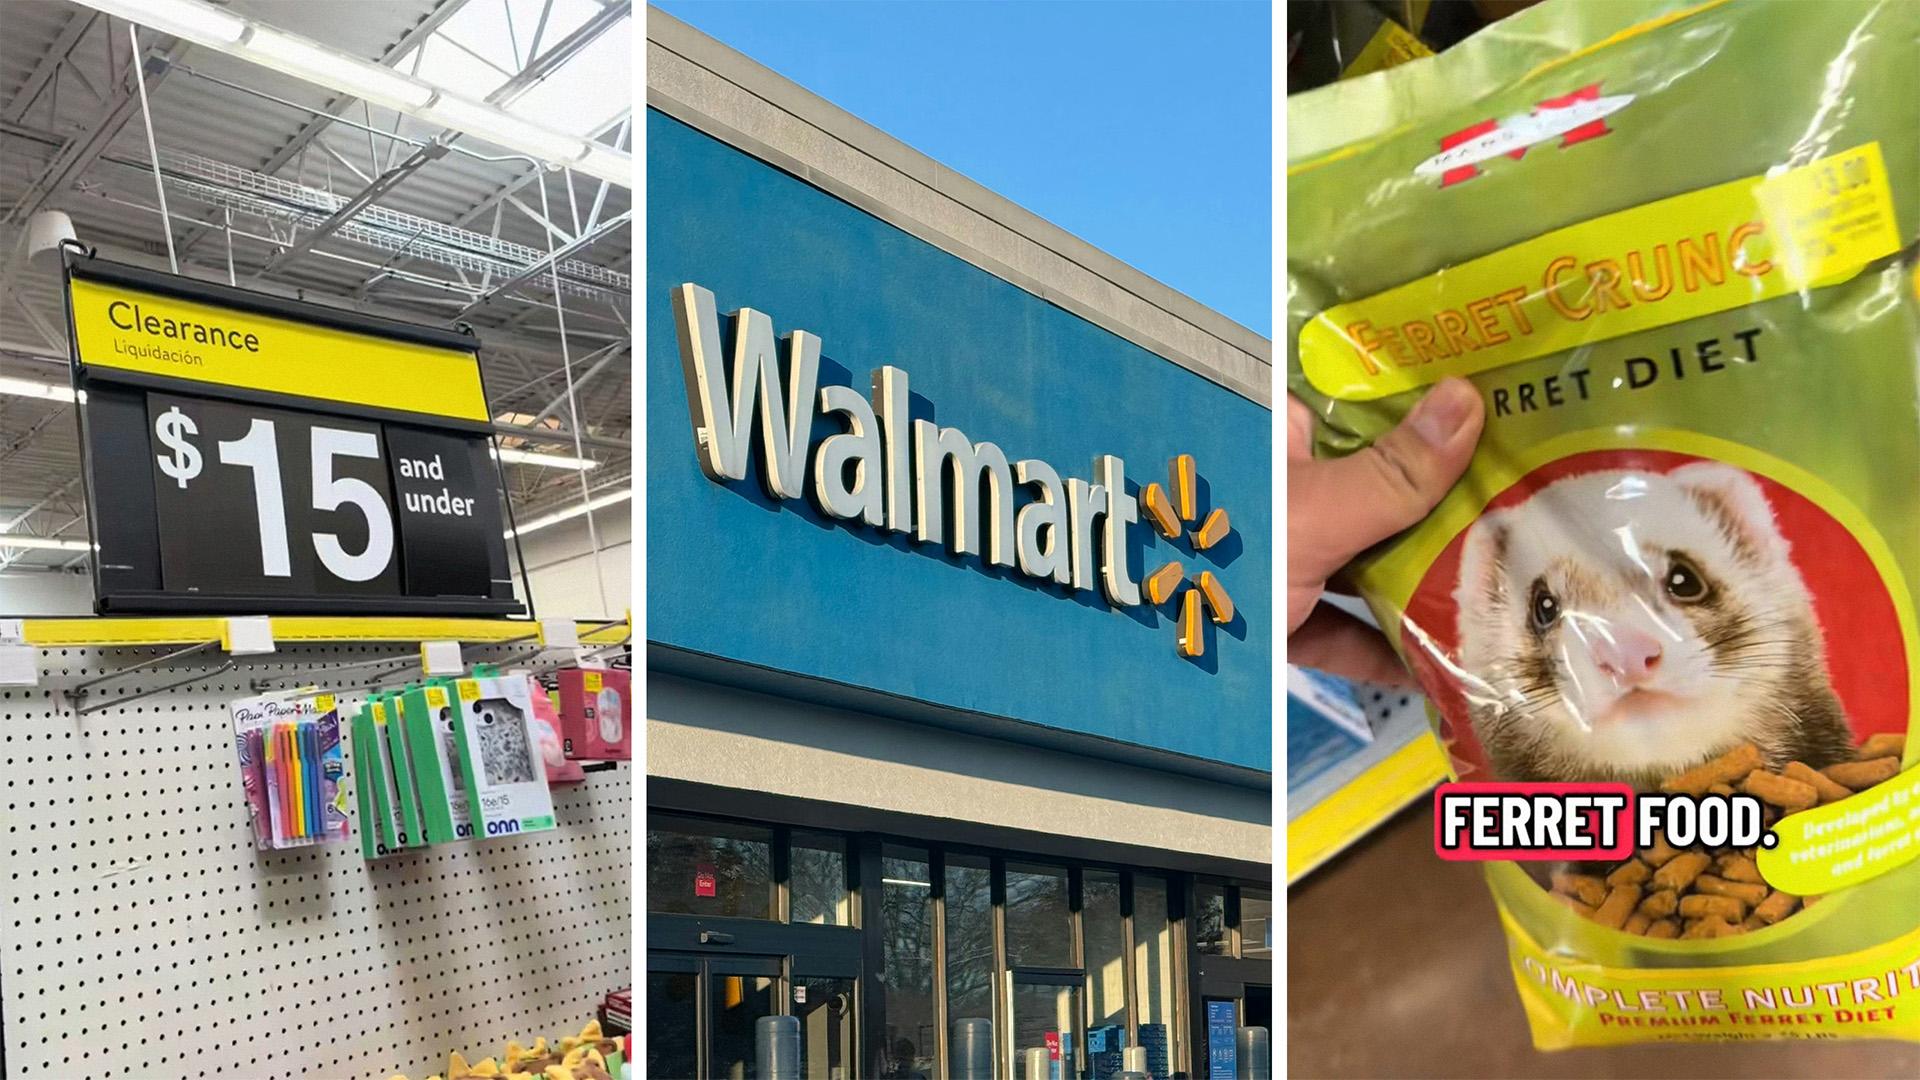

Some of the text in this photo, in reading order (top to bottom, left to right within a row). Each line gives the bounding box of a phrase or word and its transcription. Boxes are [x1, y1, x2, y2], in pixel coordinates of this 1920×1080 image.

[1346, 222, 1775, 375] FERRET CRUNC
[108, 301, 260, 353] Clearance
[113, 338, 203, 367] Liquidación
[1493, 327, 1763, 418] RRET DIET
[671, 283, 1141, 606] Walmart
[400, 455, 444, 481] and
[405, 489, 474, 517] under
[456, 822, 474, 837] on
[487, 819, 520, 835] onn
[1523, 956, 1920, 1012] OMPLETE NUTRIT
[1600, 1005, 1896, 1026] PREMIUM FERRET DIET
